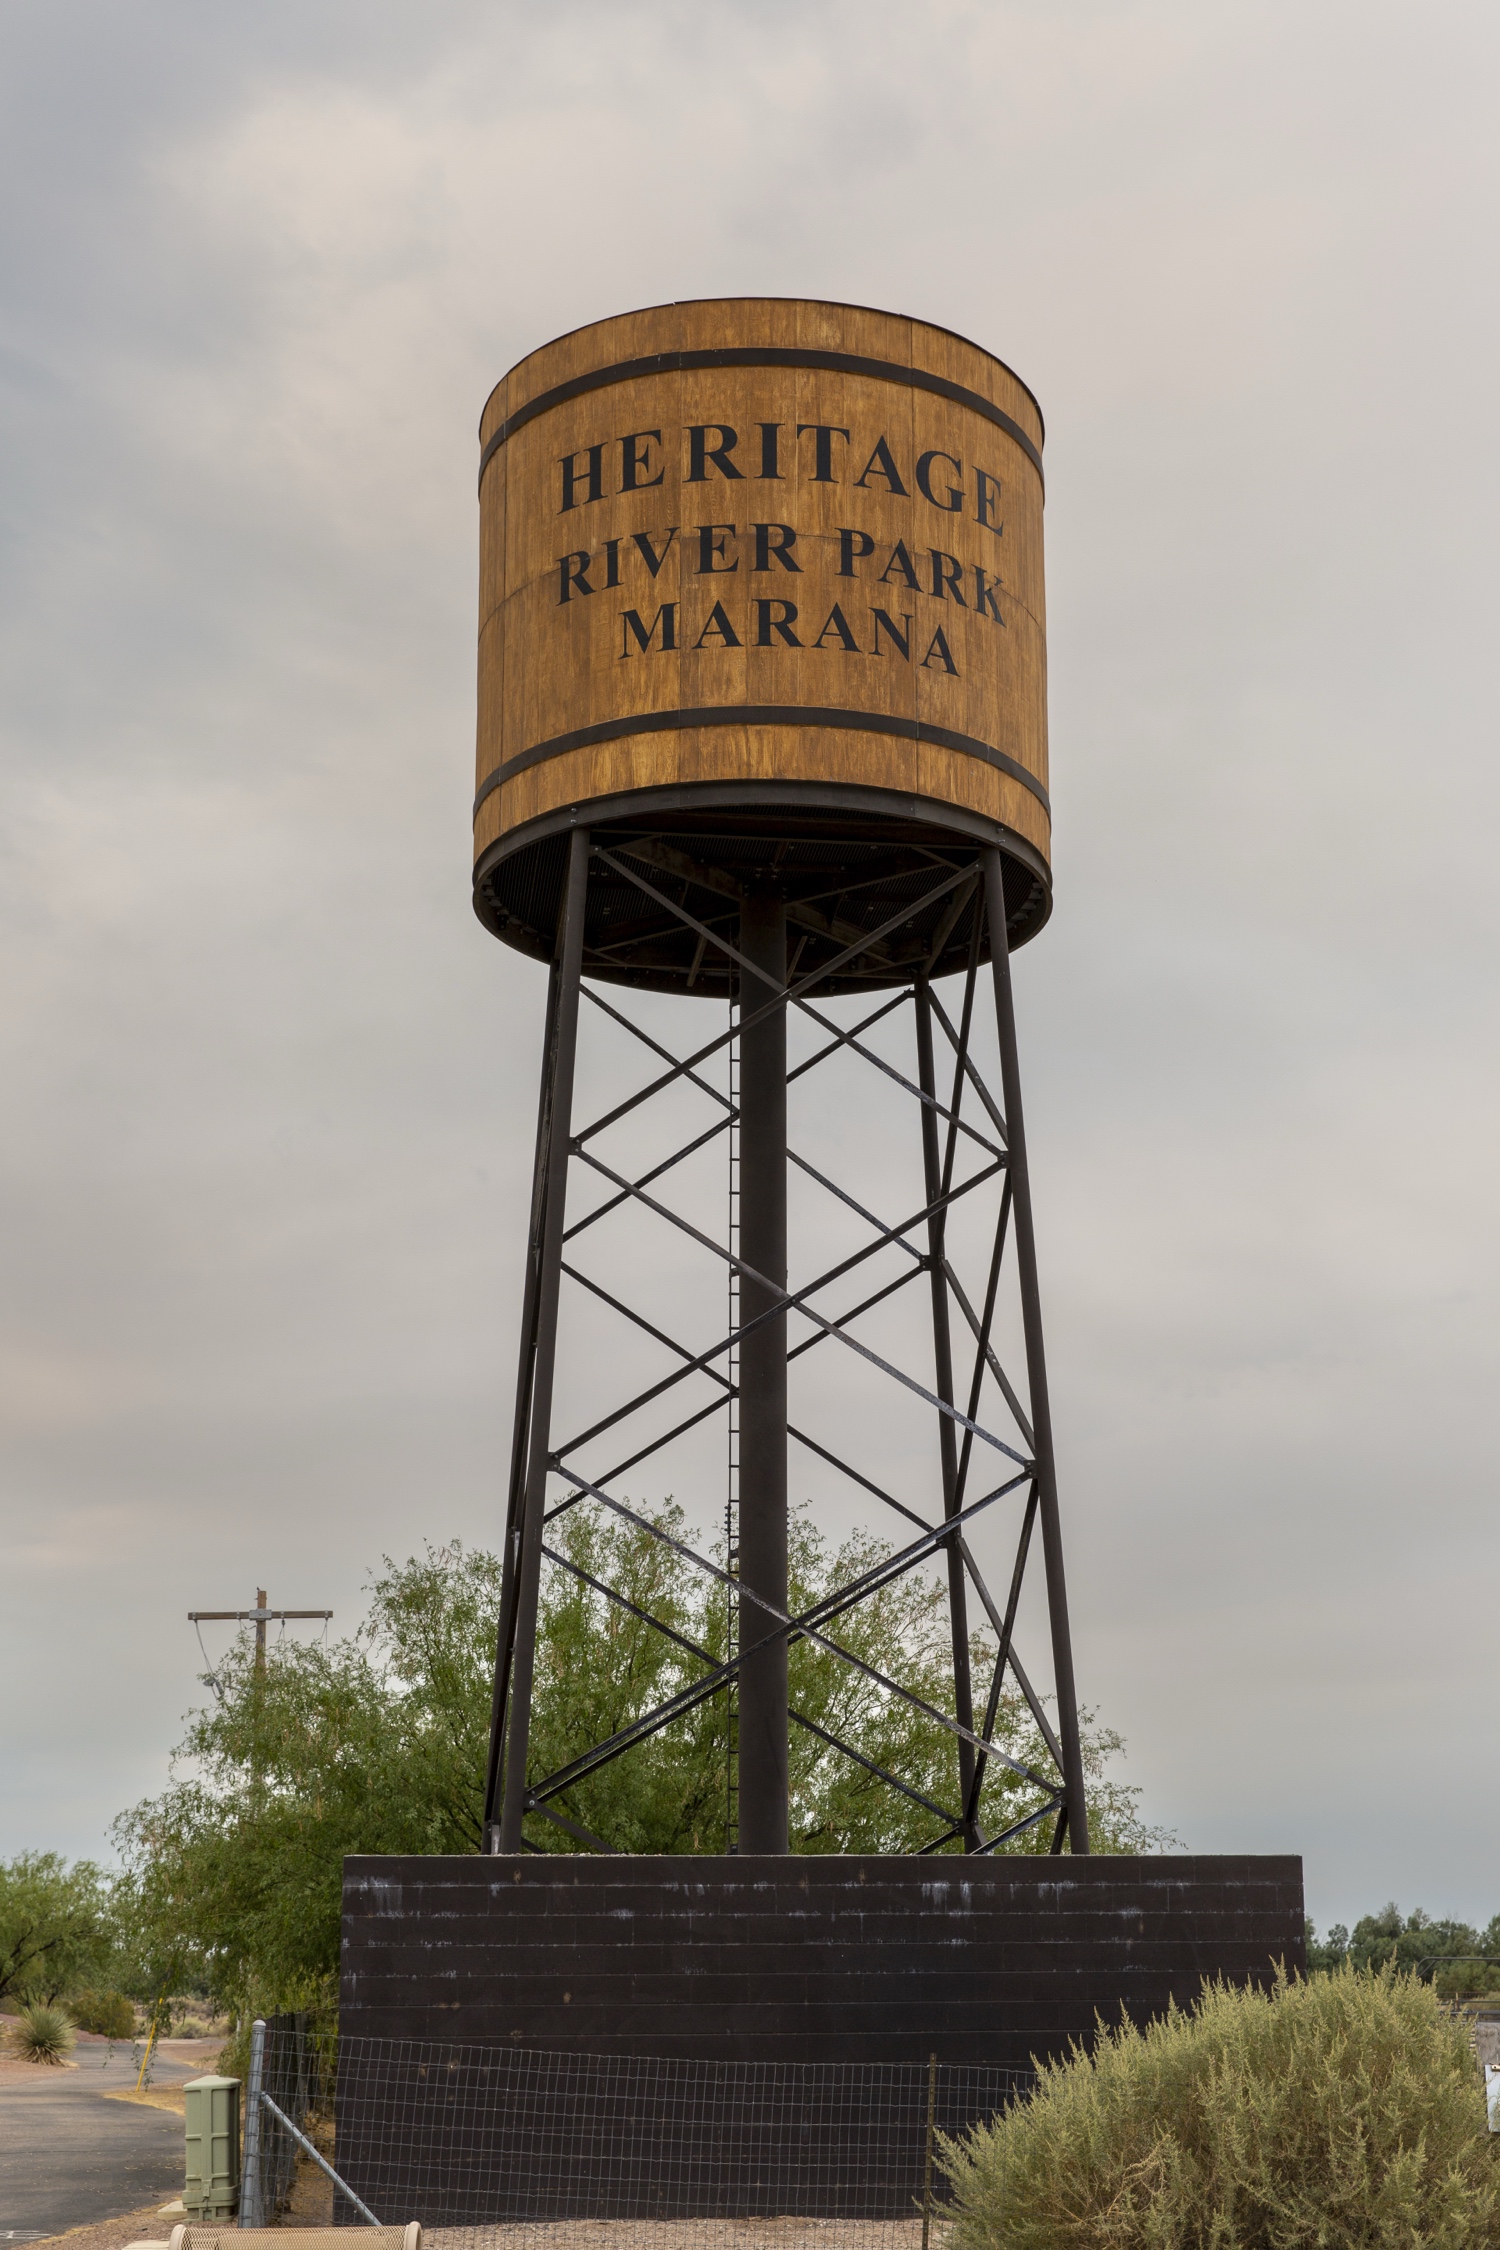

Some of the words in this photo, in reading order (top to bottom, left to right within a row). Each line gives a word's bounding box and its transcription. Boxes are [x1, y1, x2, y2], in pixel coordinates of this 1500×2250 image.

[556, 422, 1004, 537] HERITAGE
[556, 523, 804, 606] RIVER
[835, 527, 1007, 628] PARK
[617, 598, 961, 678] MARANA
